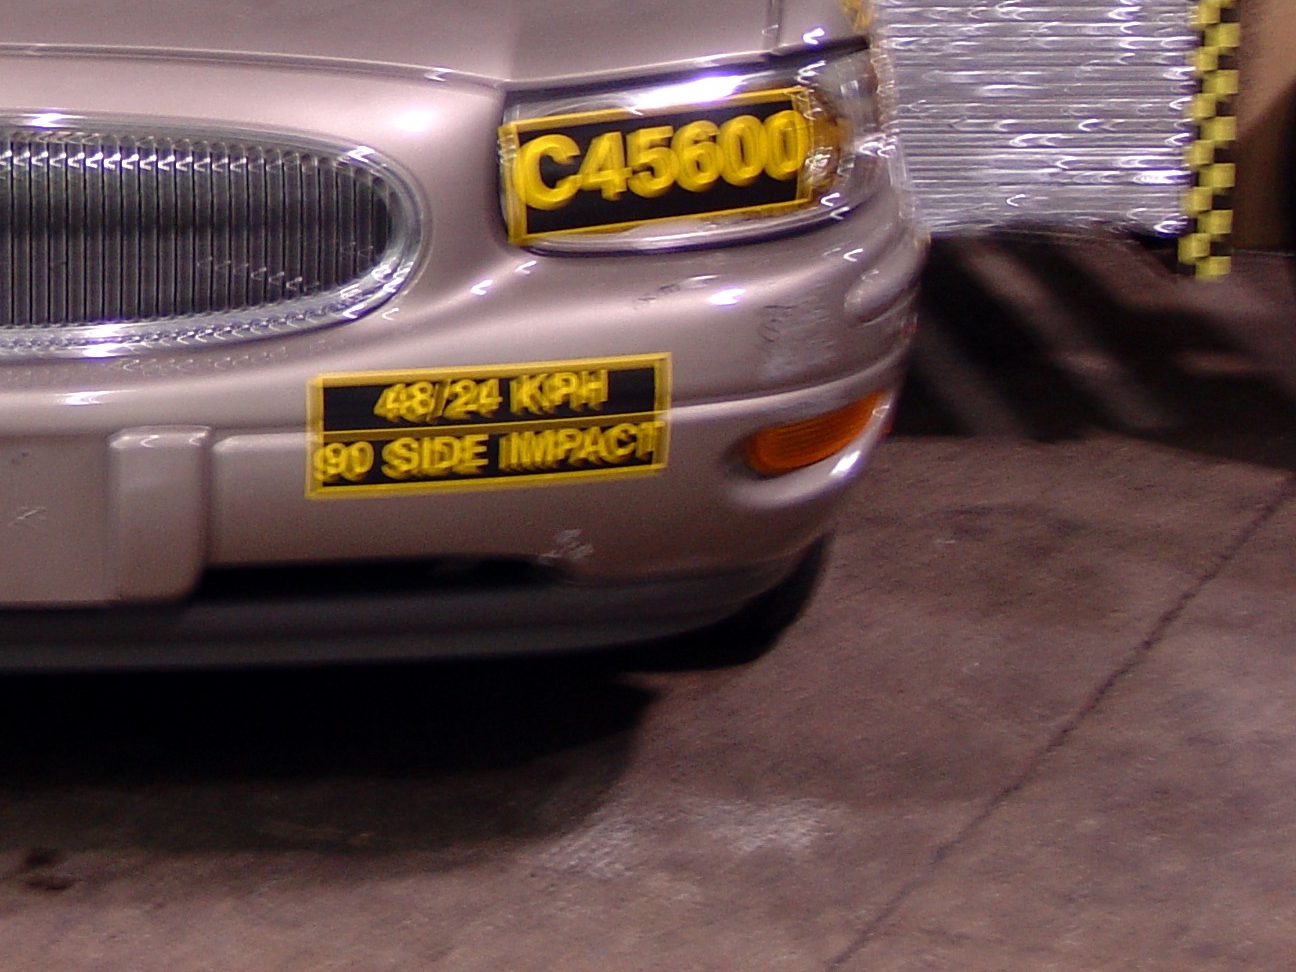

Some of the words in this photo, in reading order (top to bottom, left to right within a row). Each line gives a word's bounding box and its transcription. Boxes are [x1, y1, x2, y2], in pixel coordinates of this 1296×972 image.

[513, 109, 805, 210] C45600
[374, 378, 502, 423] 48/24
[510, 369, 608, 415] KPH
[315, 441, 374, 481] 90
[382, 434, 488, 478] SIDE
[499, 421, 664, 471] IMPACT
